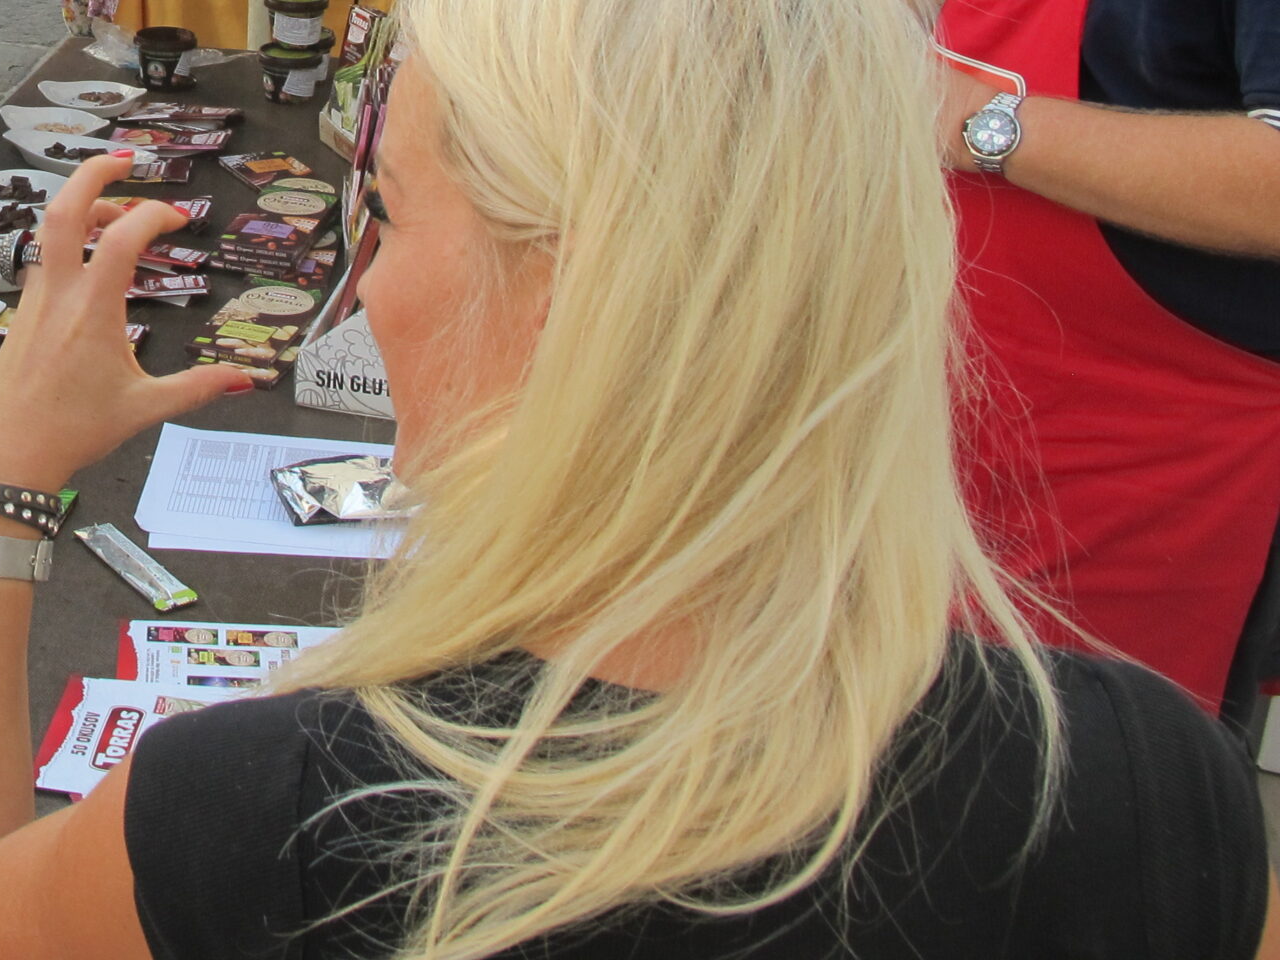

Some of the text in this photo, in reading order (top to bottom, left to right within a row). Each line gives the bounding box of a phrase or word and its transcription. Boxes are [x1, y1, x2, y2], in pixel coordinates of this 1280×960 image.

[316, 370, 390, 397] SIN GLUT
[71, 711, 101, 756] 50 OKUSOV
[94, 710, 140, 766] TORRAS
